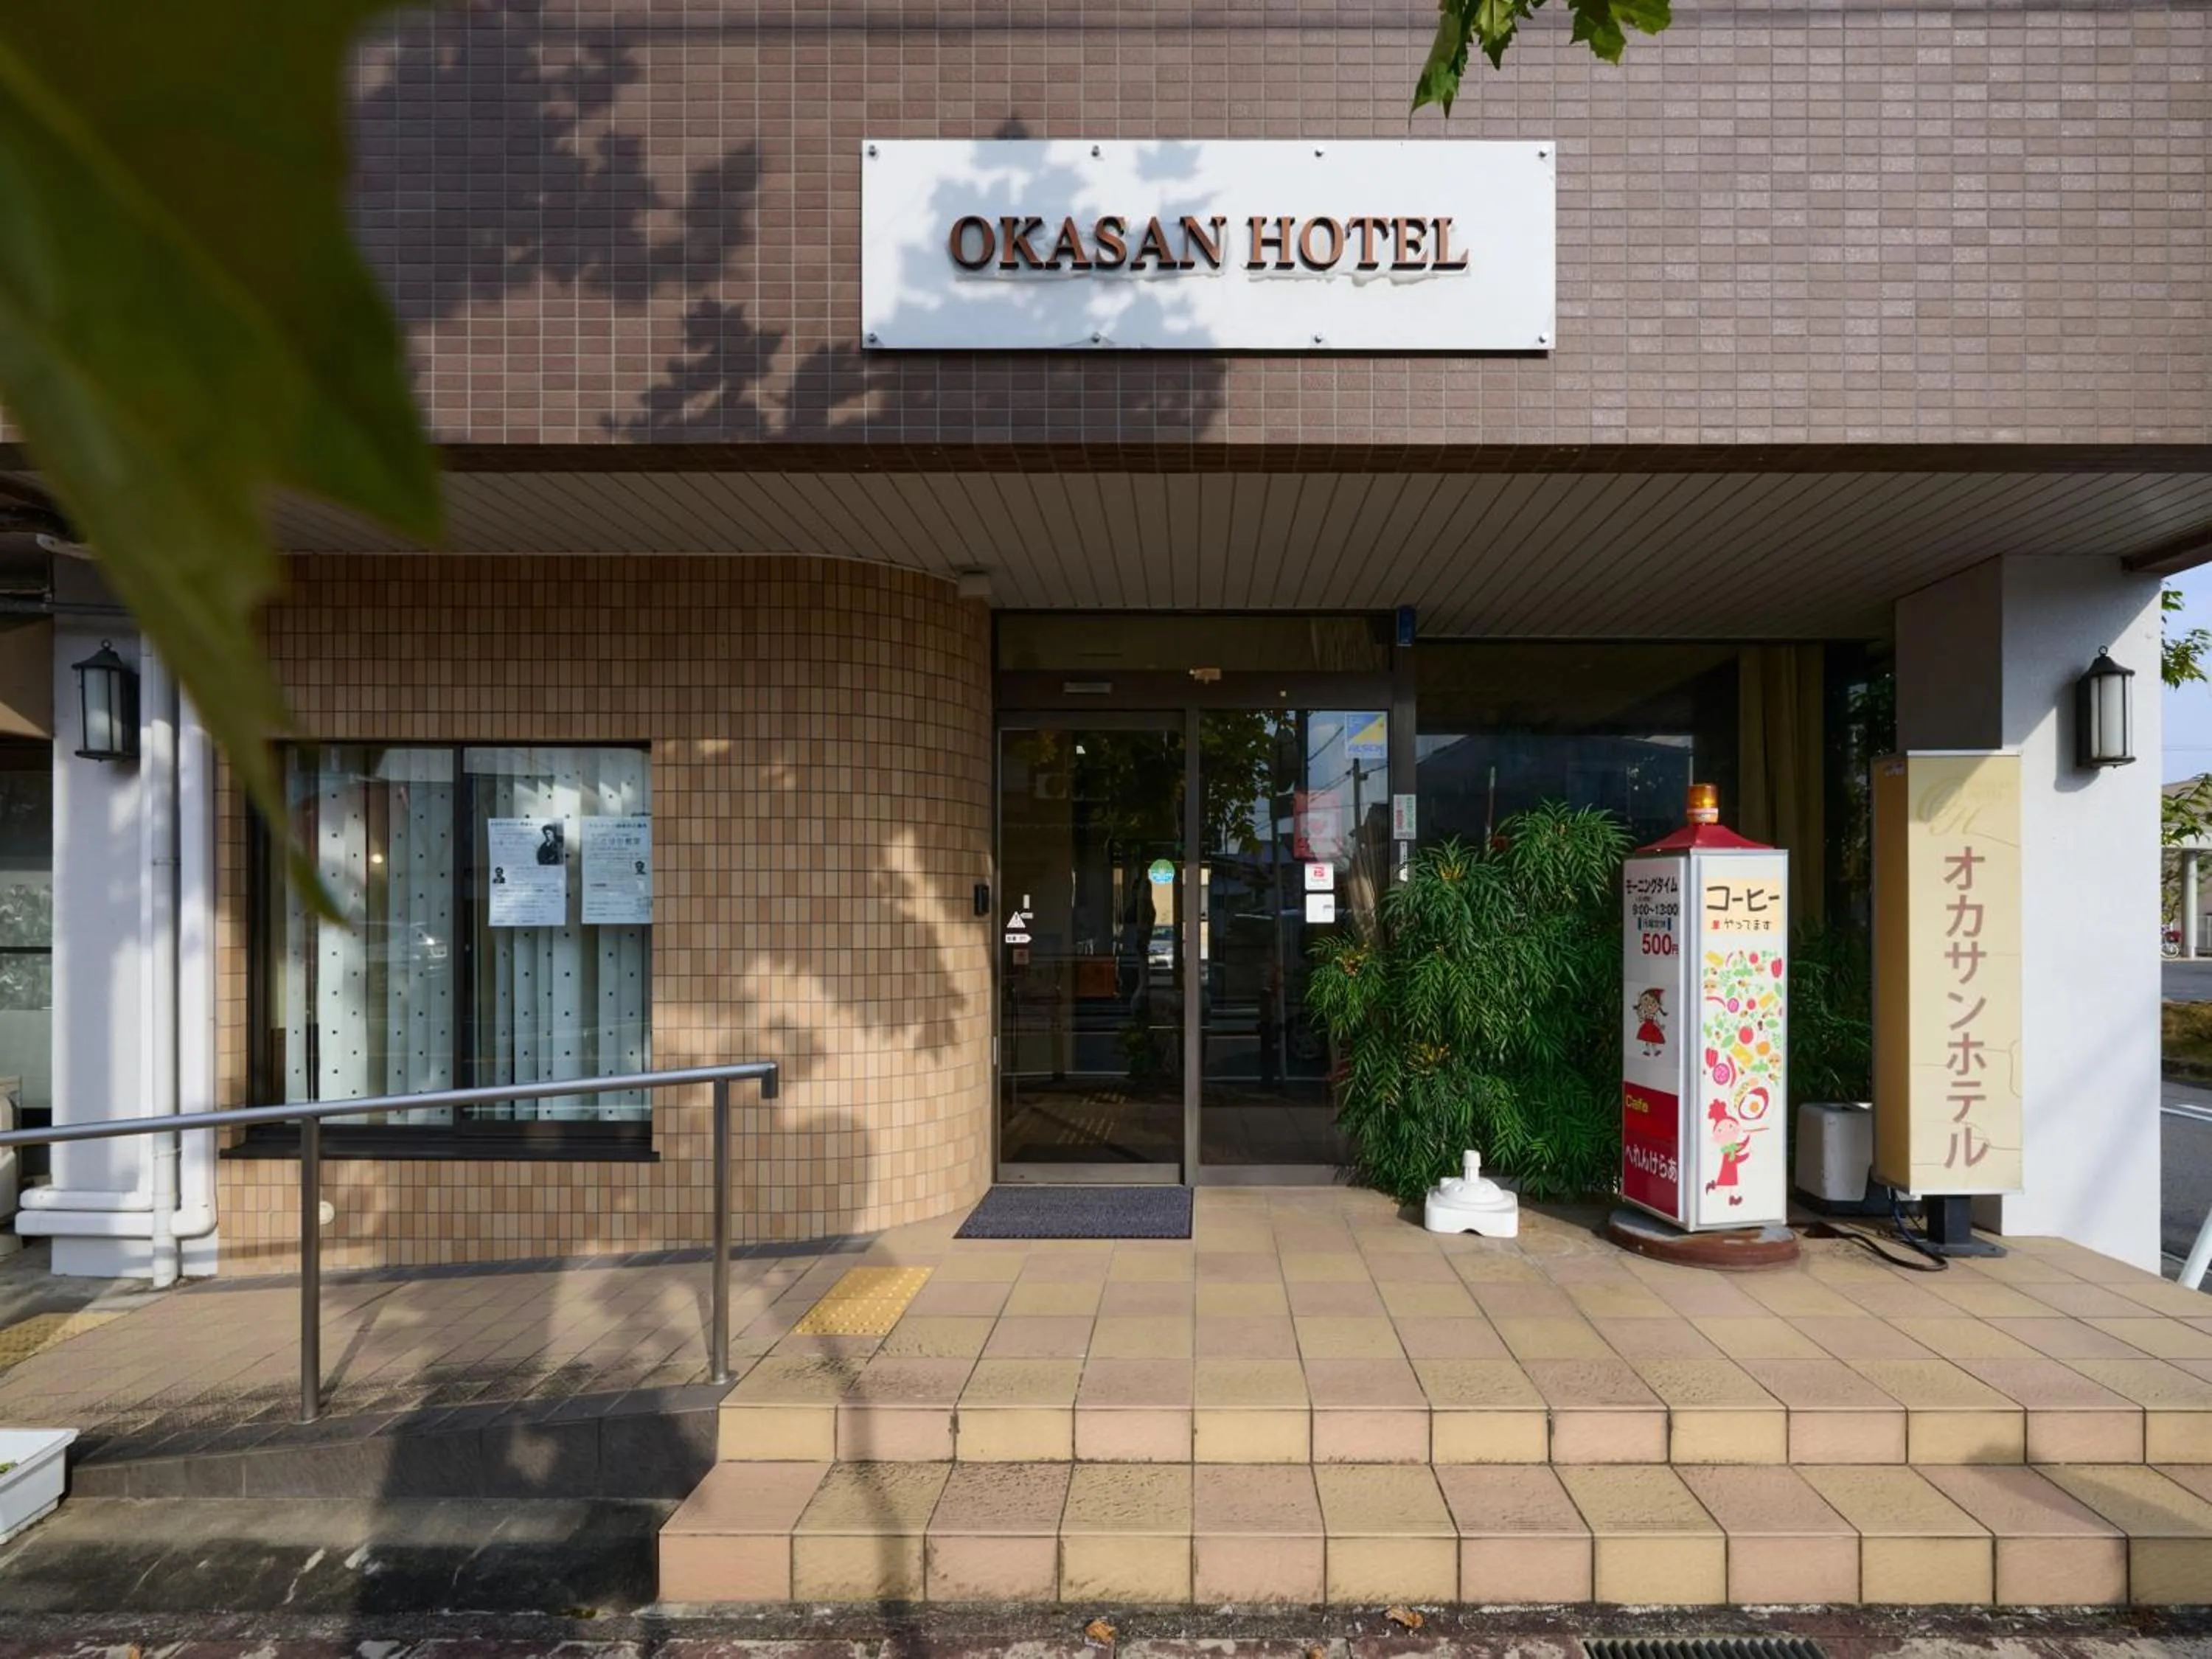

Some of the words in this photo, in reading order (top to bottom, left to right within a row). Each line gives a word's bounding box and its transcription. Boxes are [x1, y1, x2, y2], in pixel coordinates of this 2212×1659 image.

[949, 215, 1227, 271] OKASAN
[1246, 215, 1469, 271] HOTEL
[1706, 886, 1780, 911] コーヒー
[1944, 846, 1989, 1169] オカサンホテル
